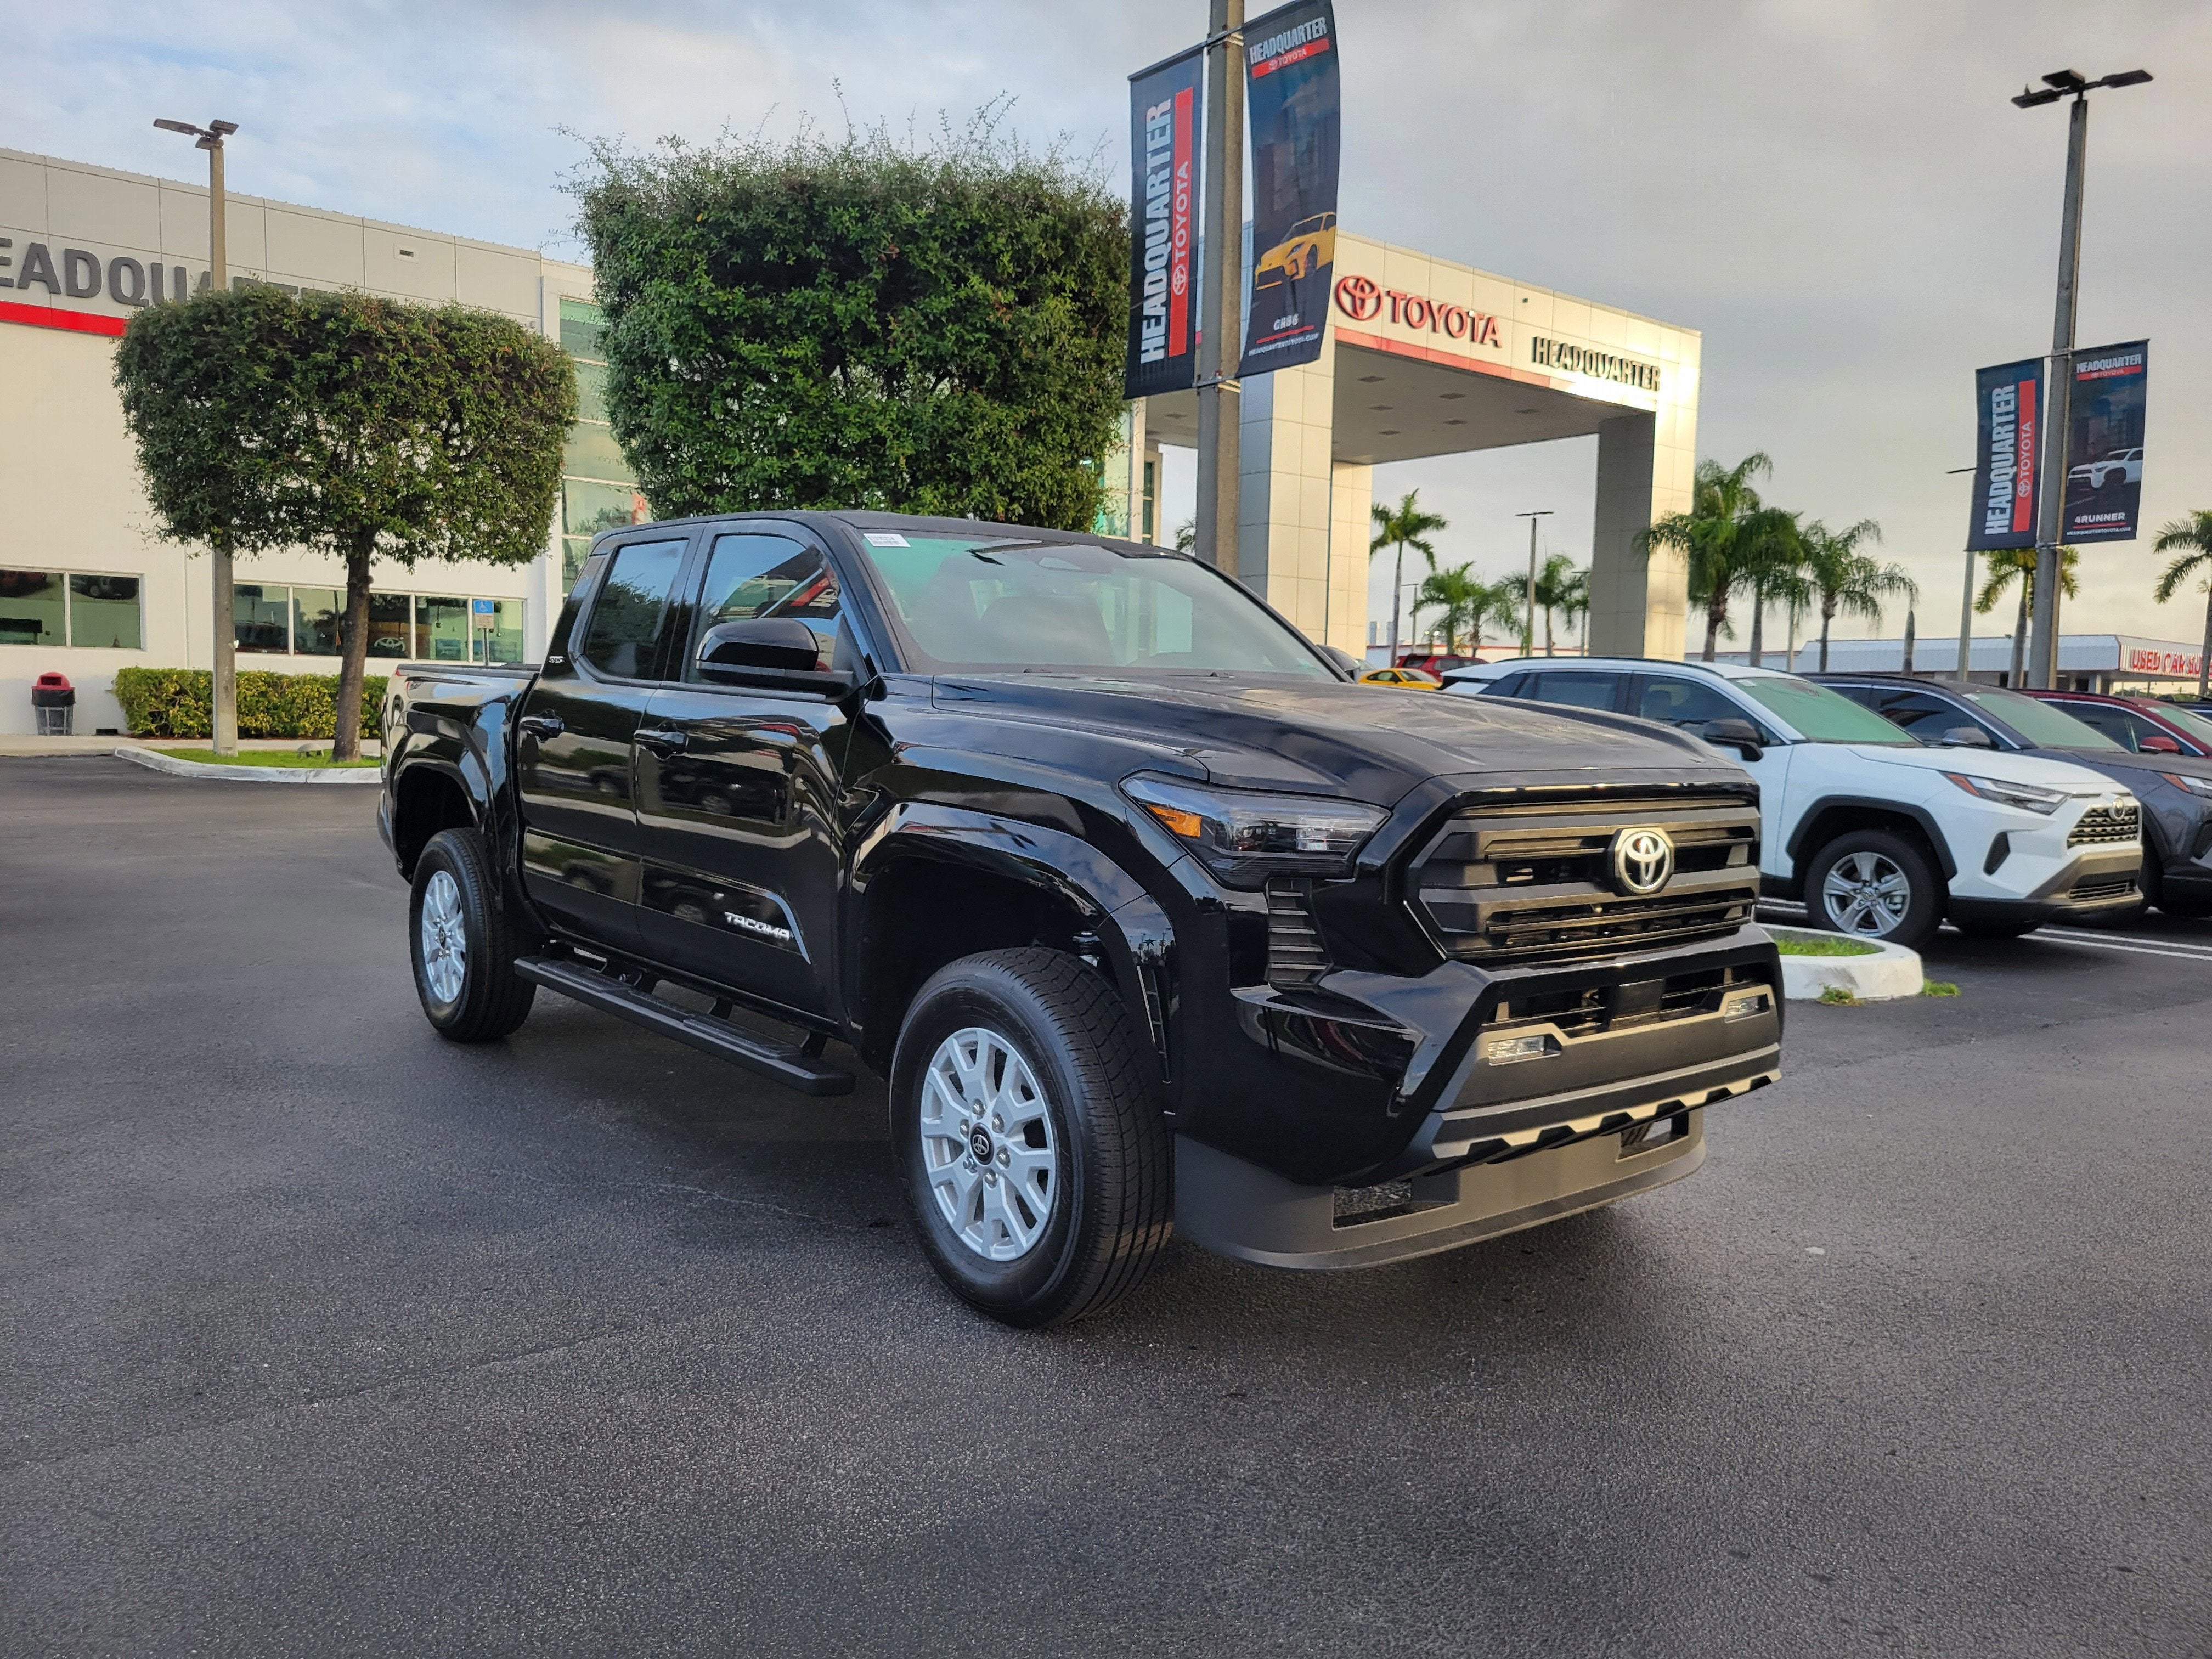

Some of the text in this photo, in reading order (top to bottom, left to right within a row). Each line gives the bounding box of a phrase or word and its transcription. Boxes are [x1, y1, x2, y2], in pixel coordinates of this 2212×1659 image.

[1249, 16, 1328, 65] HEADQUARTER
[1277, 48, 1307, 66] TOYOTA
[1140, 98, 1172, 364] HEADQUARTER
[1175, 161, 1189, 264] TOYOTA
[1386, 289, 1503, 348] TOYOTA
[1531, 336, 1661, 391] HEADQUARTER
[2076, 354, 2142, 374] HEADQUARTER
[2099, 369, 2124, 377] TOYOTA
[1984, 384, 2017, 535] HEADQUARTER
[2020, 421, 2032, 479] TOYOTA
[2074, 512, 2126, 524] 4RUNNER
[2132, 650, 2161, 671] USED
[724, 911, 790, 941] TACOMA
